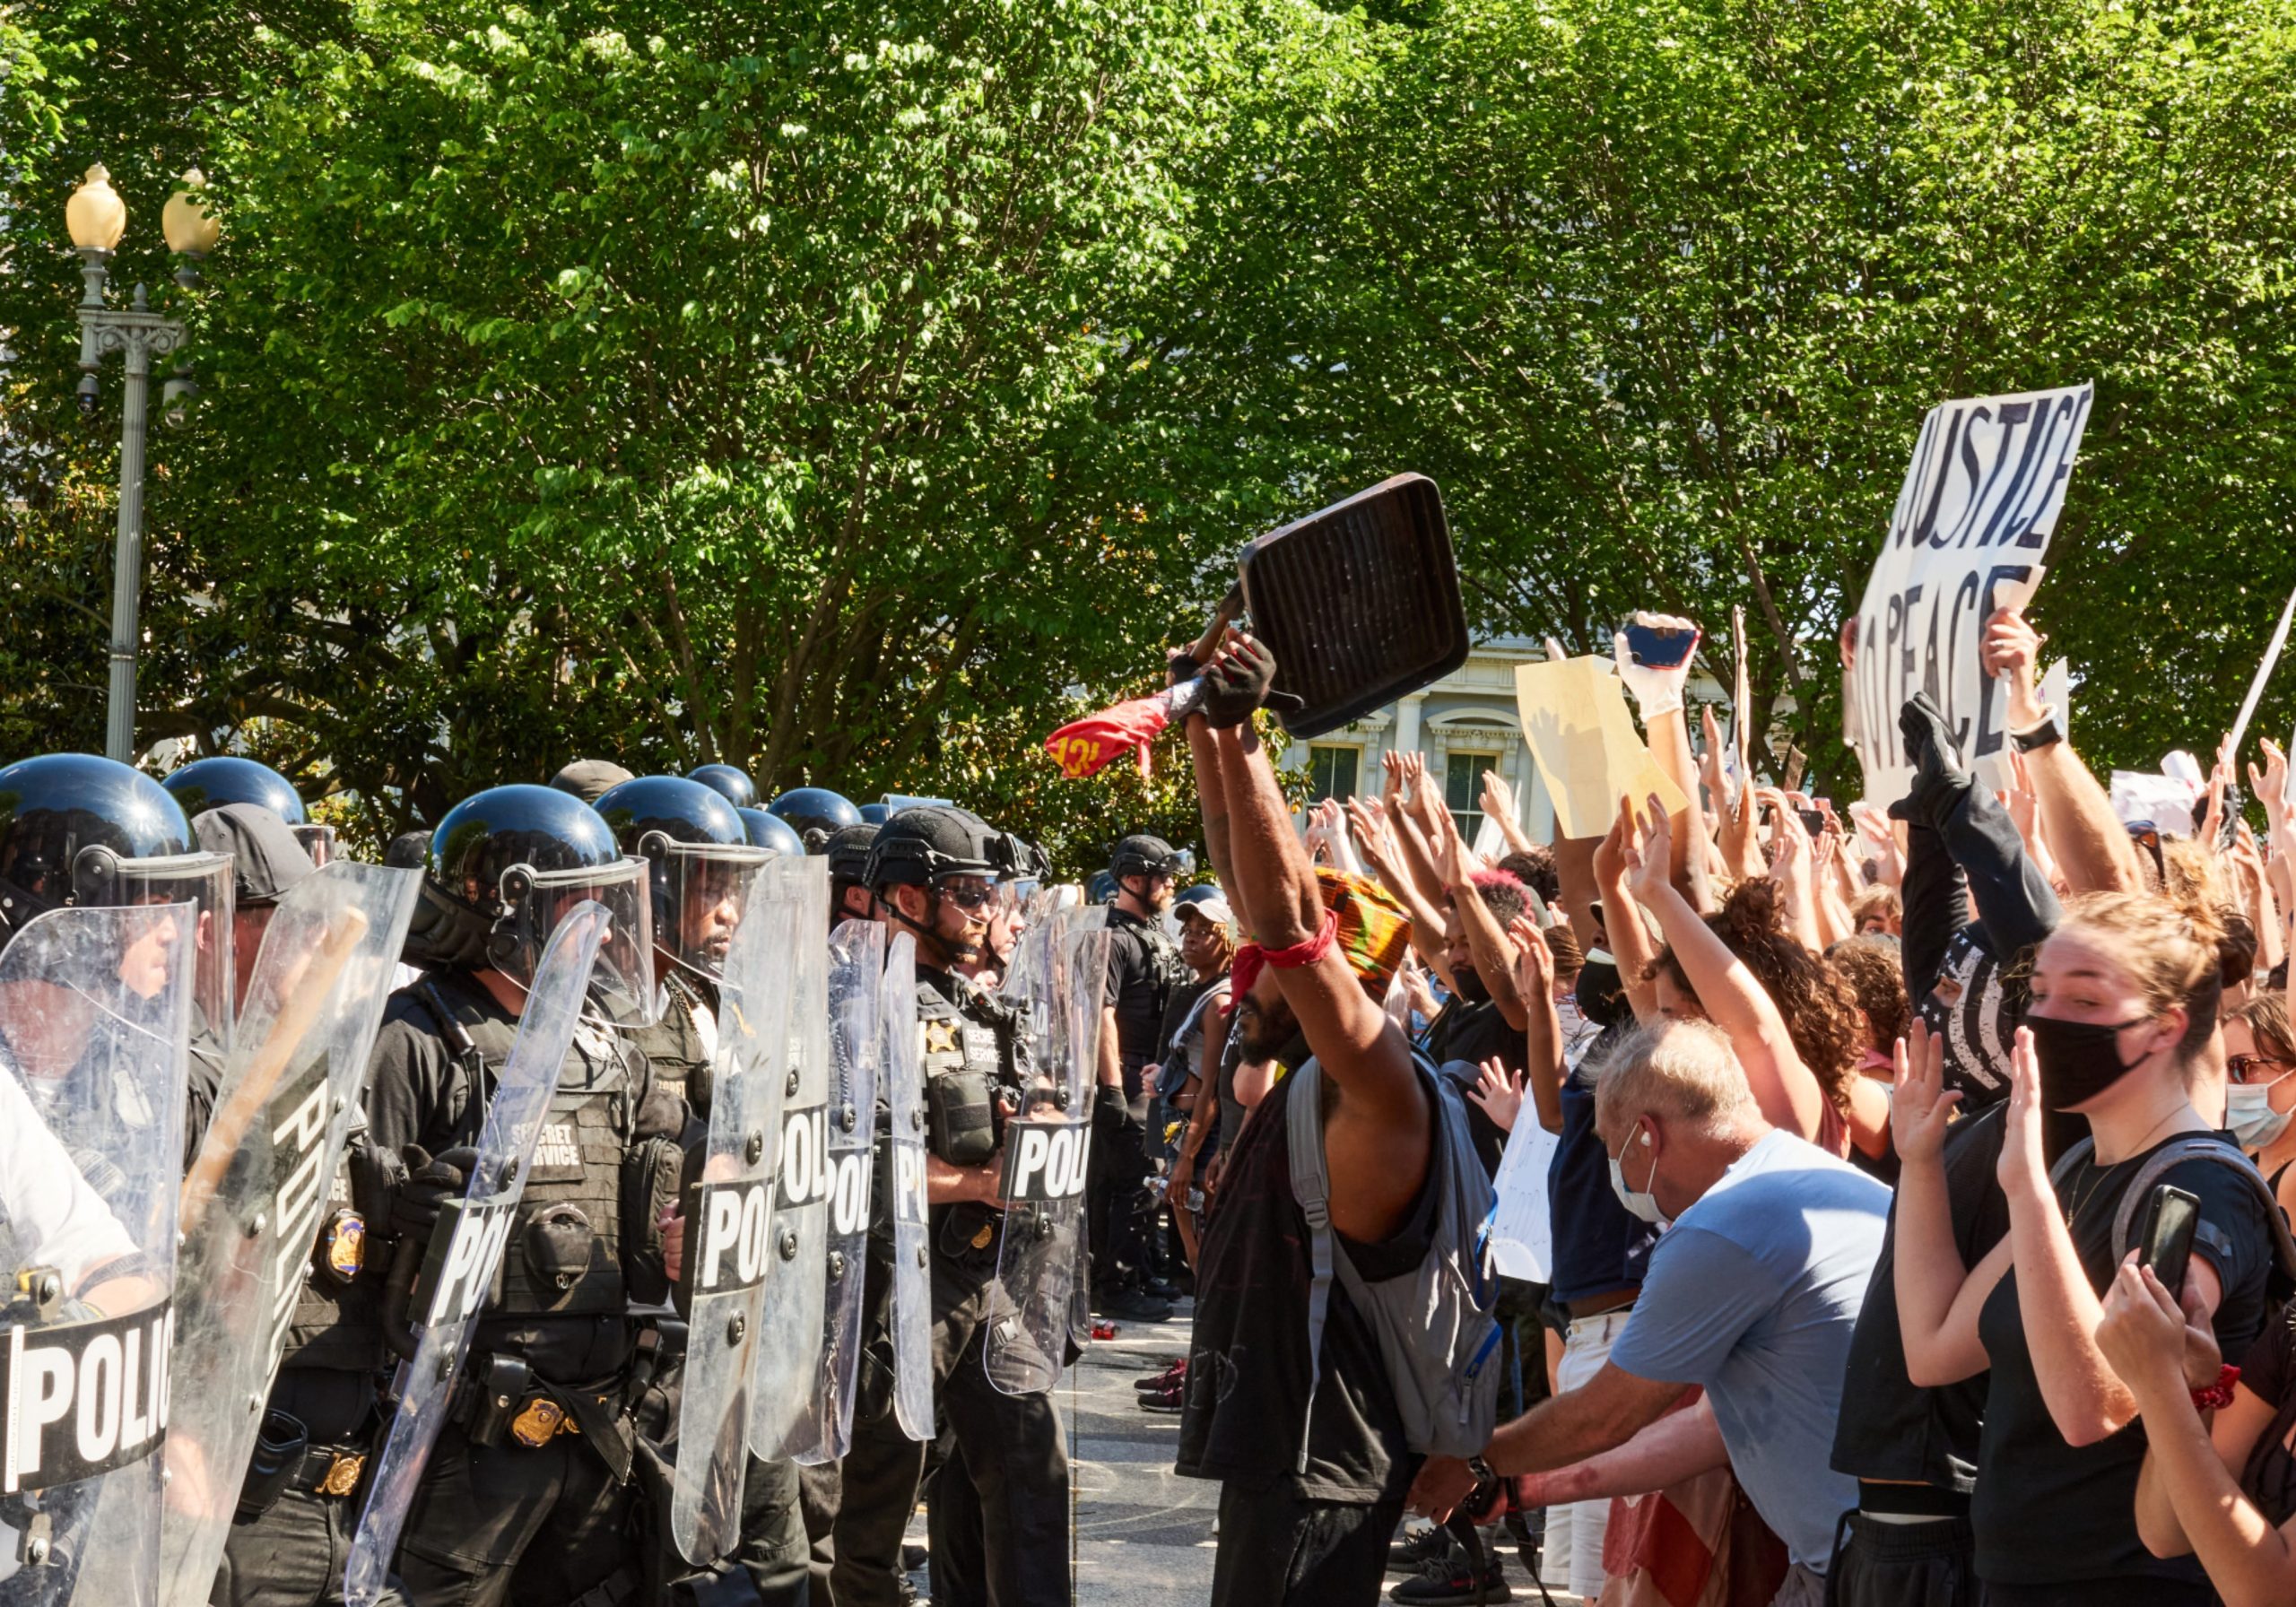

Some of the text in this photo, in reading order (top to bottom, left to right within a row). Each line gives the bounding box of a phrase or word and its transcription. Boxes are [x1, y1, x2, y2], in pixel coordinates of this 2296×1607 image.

[1896, 388, 2092, 551] JUSTICE
[1885, 563, 2034, 769] PEACE
[508, 1144, 580, 1165] RVICE
